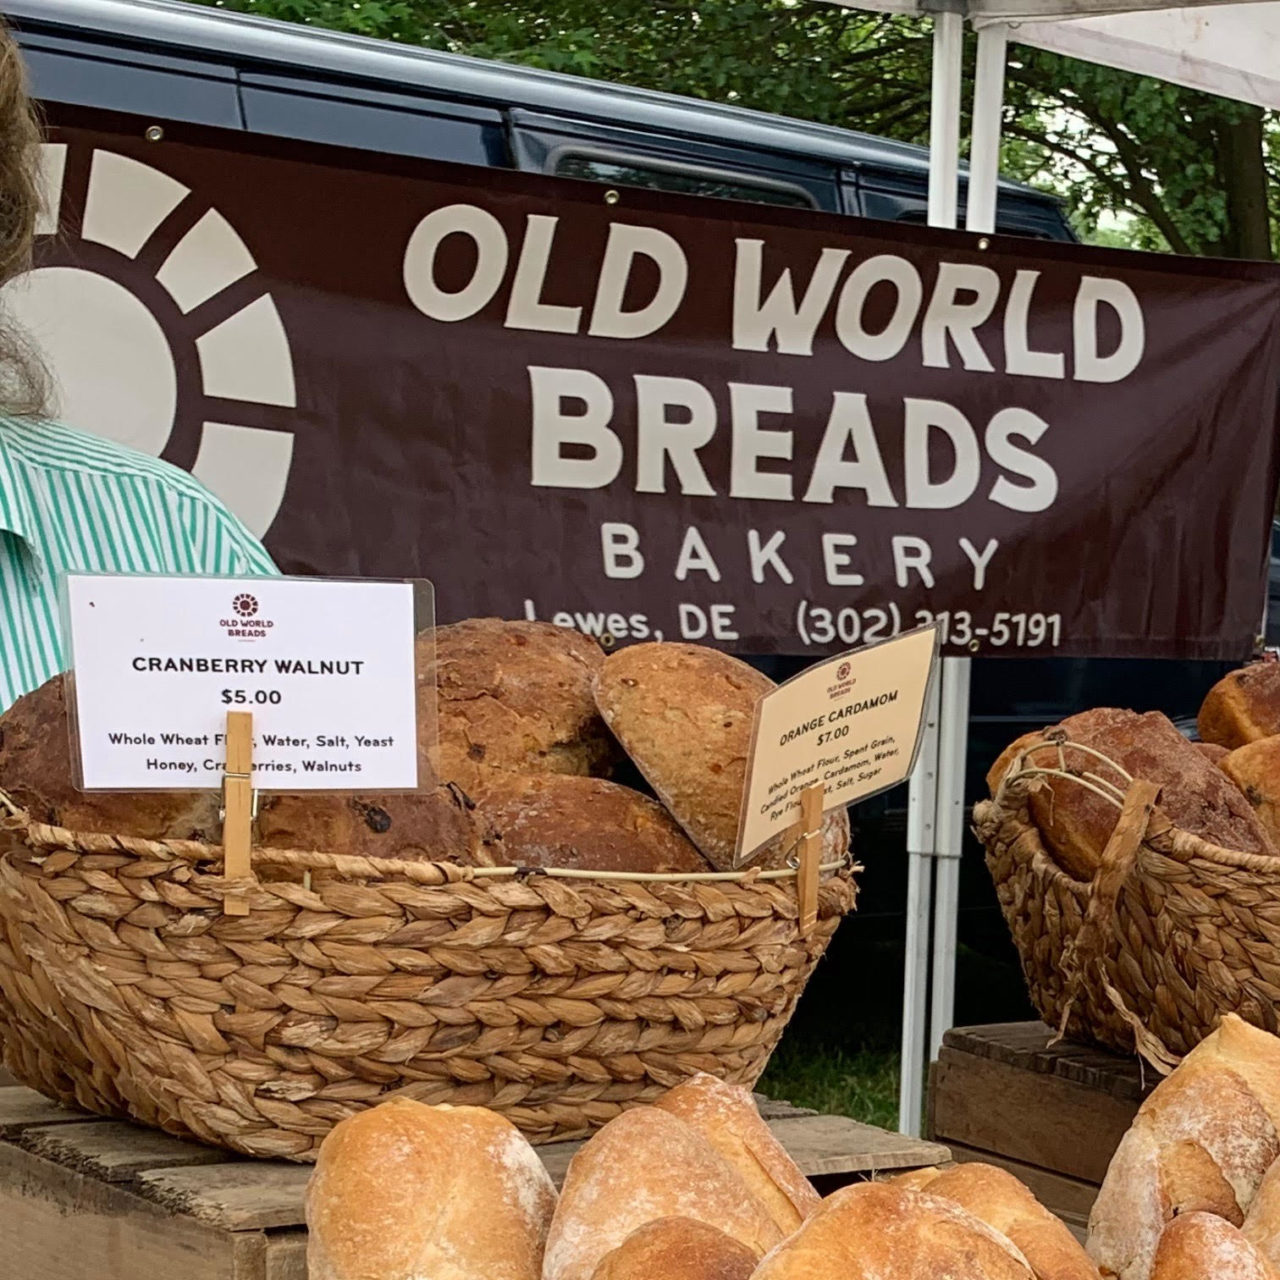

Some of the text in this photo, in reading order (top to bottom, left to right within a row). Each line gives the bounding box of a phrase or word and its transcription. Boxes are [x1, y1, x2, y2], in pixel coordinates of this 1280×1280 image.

[402, 203, 1145, 384] OLD WORLD
[527, 364, 1059, 513] BREADS
[601, 522, 999, 591] BAKERY
[219, 619, 274, 629] OLD WORLD
[679, 604, 739, 641] DE
[797, 600, 900, 645] (302)
[228, 629, 266, 638] BREADS
[132, 656, 365, 676] CRANBERRY WALNUT
[221, 688, 282, 705] $5.00
[779, 690, 899, 747] ORANGE CARDAMOM
[108, 733, 155, 746] Whole
[160, 733, 209, 746] Wheat
[262, 735, 309, 748] Water,
[316, 735, 349, 749] Salt,
[354, 735, 394, 747] Yeast
[816, 725, 850, 746] $7.00
[147, 758, 362, 774] Honey, Craerries, Walnuts
[790, 764, 815, 780] Wheat
[843, 744, 868, 760] Spent
[857, 767, 882, 783] Sugar
